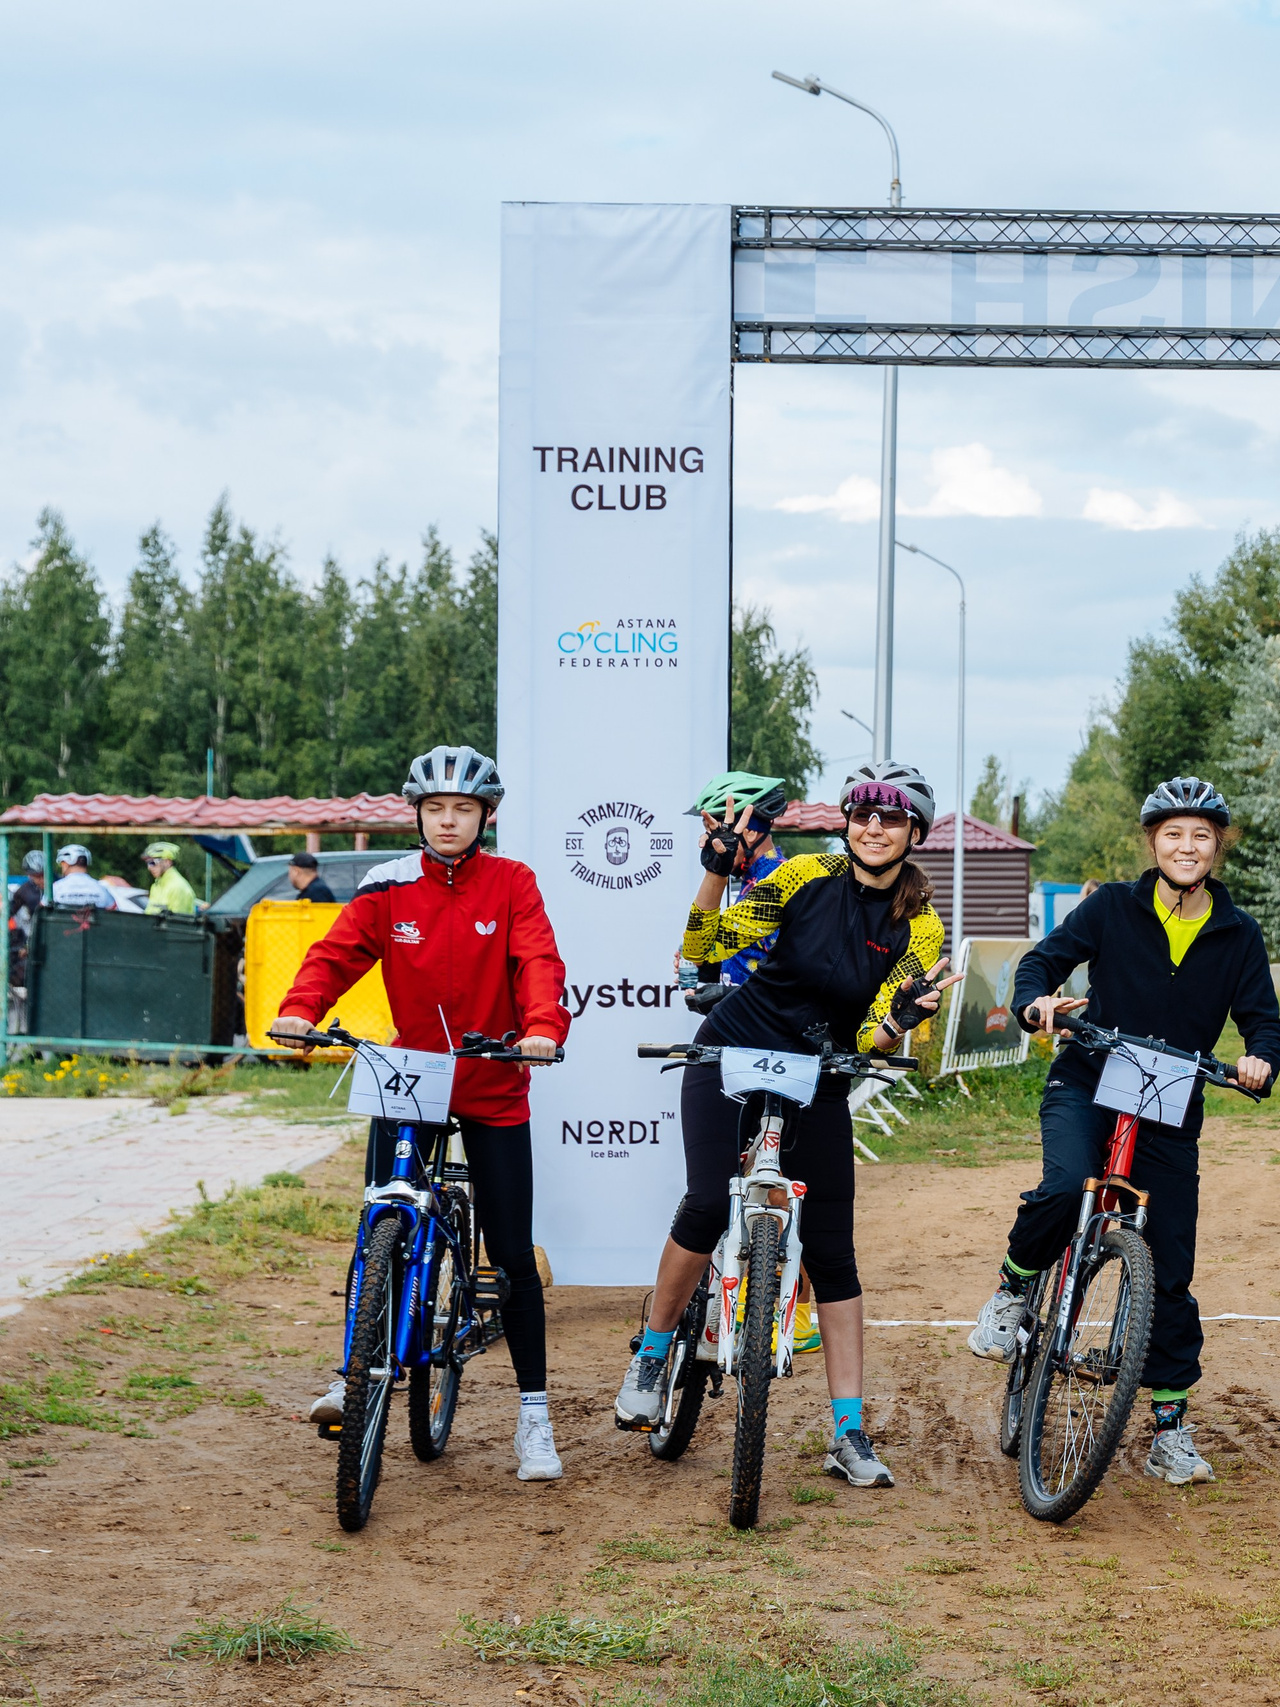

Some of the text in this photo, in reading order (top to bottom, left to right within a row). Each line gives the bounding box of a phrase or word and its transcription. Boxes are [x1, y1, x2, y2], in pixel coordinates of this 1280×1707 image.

[533, 446, 704, 473] TRAINING
[571, 484, 667, 511] CLUB
[616, 618, 677, 629] ASTANA
[558, 631, 678, 653] CYCLING
[559, 657, 678, 668] FEDERATION
[578, 801, 655, 829] TRANZITKA
[565, 838, 673, 850] EST. 2020
[570, 860, 662, 890] TRIATHLON SHOP
[560, 978, 687, 1018] ystar
[752, 1057, 786, 1075] 46
[384, 1072, 421, 1097] 47
[1139, 1072, 1157, 1094] 7
[661, 1111, 675, 1119] TM
[562, 1120, 660, 1144] NORDI
[591, 1150, 629, 1158] Ice Bath
